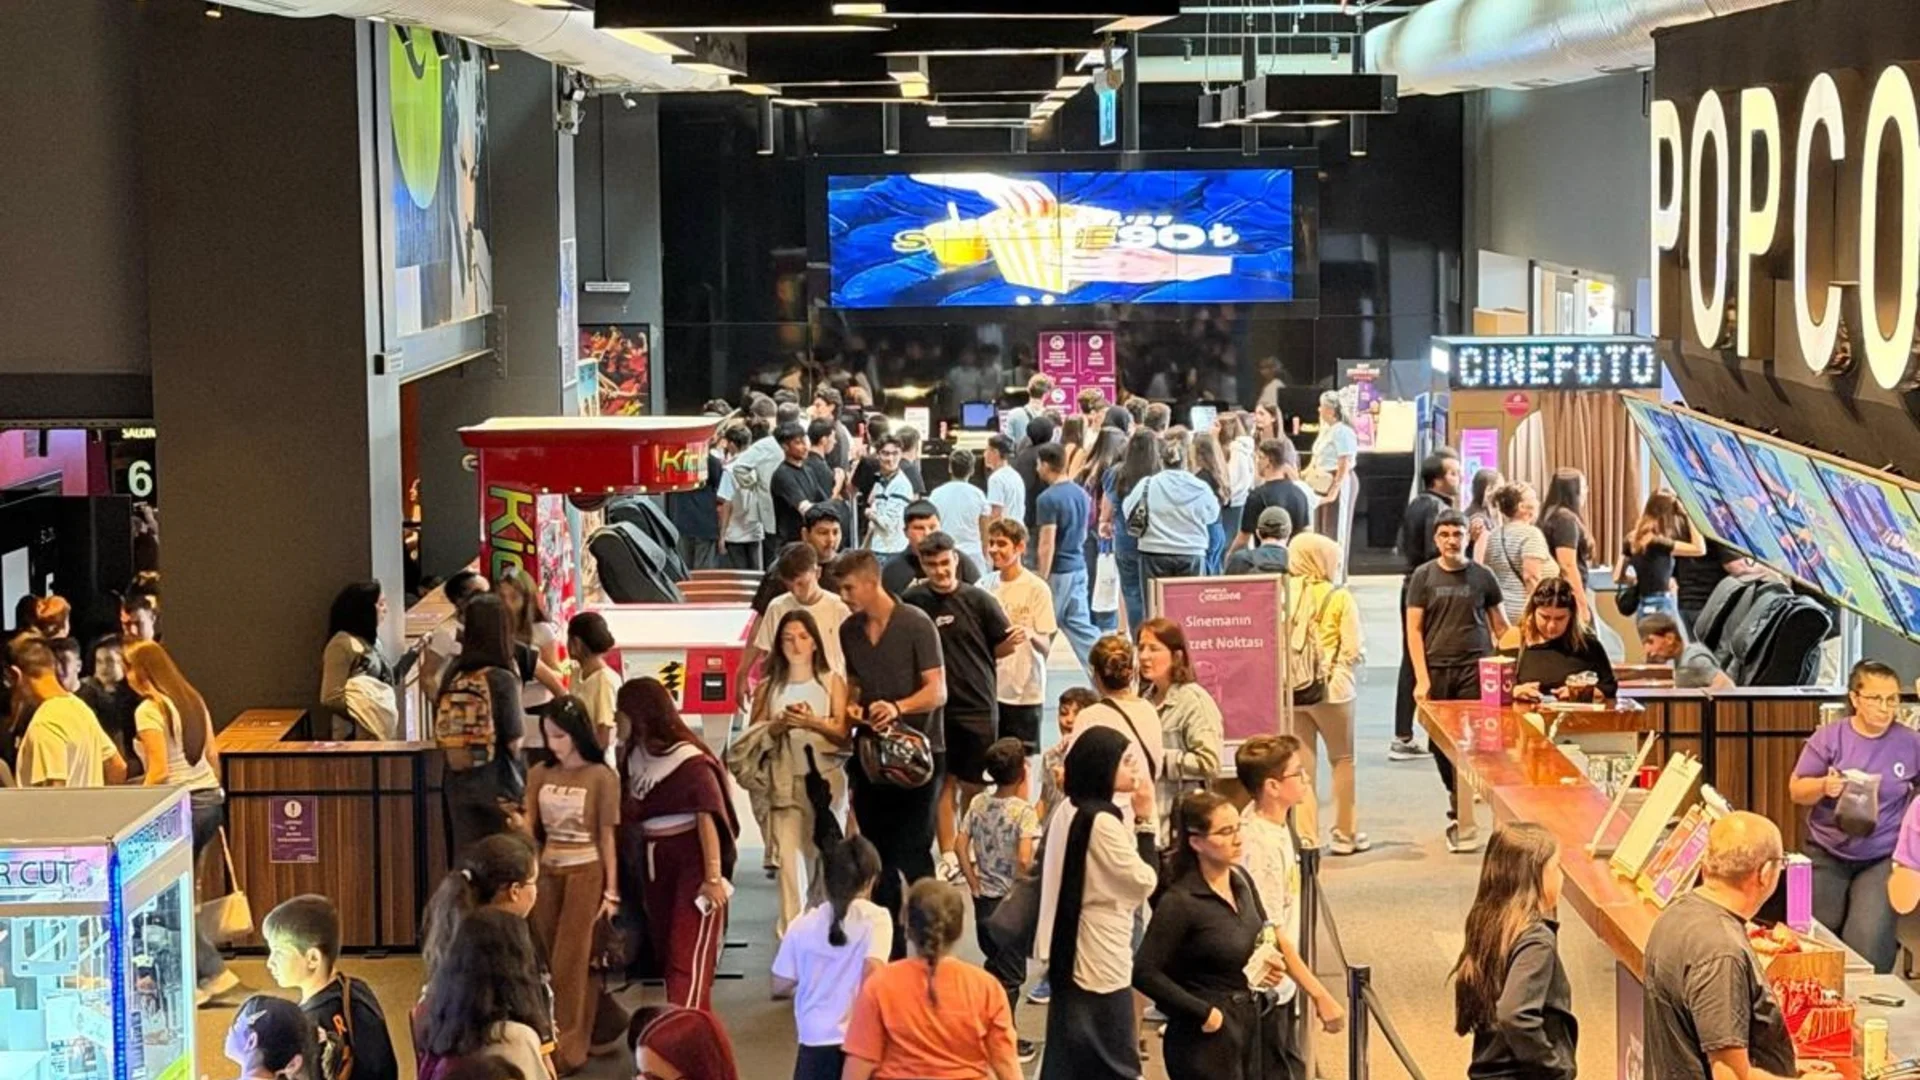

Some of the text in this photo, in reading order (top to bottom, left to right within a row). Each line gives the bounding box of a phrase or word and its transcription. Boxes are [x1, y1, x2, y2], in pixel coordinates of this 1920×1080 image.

[1651, 64, 1920, 389] POPCO
[1459, 344, 1654, 385] CINEFOTO
[122, 427, 156, 439] SALON
[128, 459, 153, 497] 6
[1185, 615, 1252, 628] Sinemanın
[1216, 636, 1264, 649] Noktası
[20, 861, 76, 885] CUT
